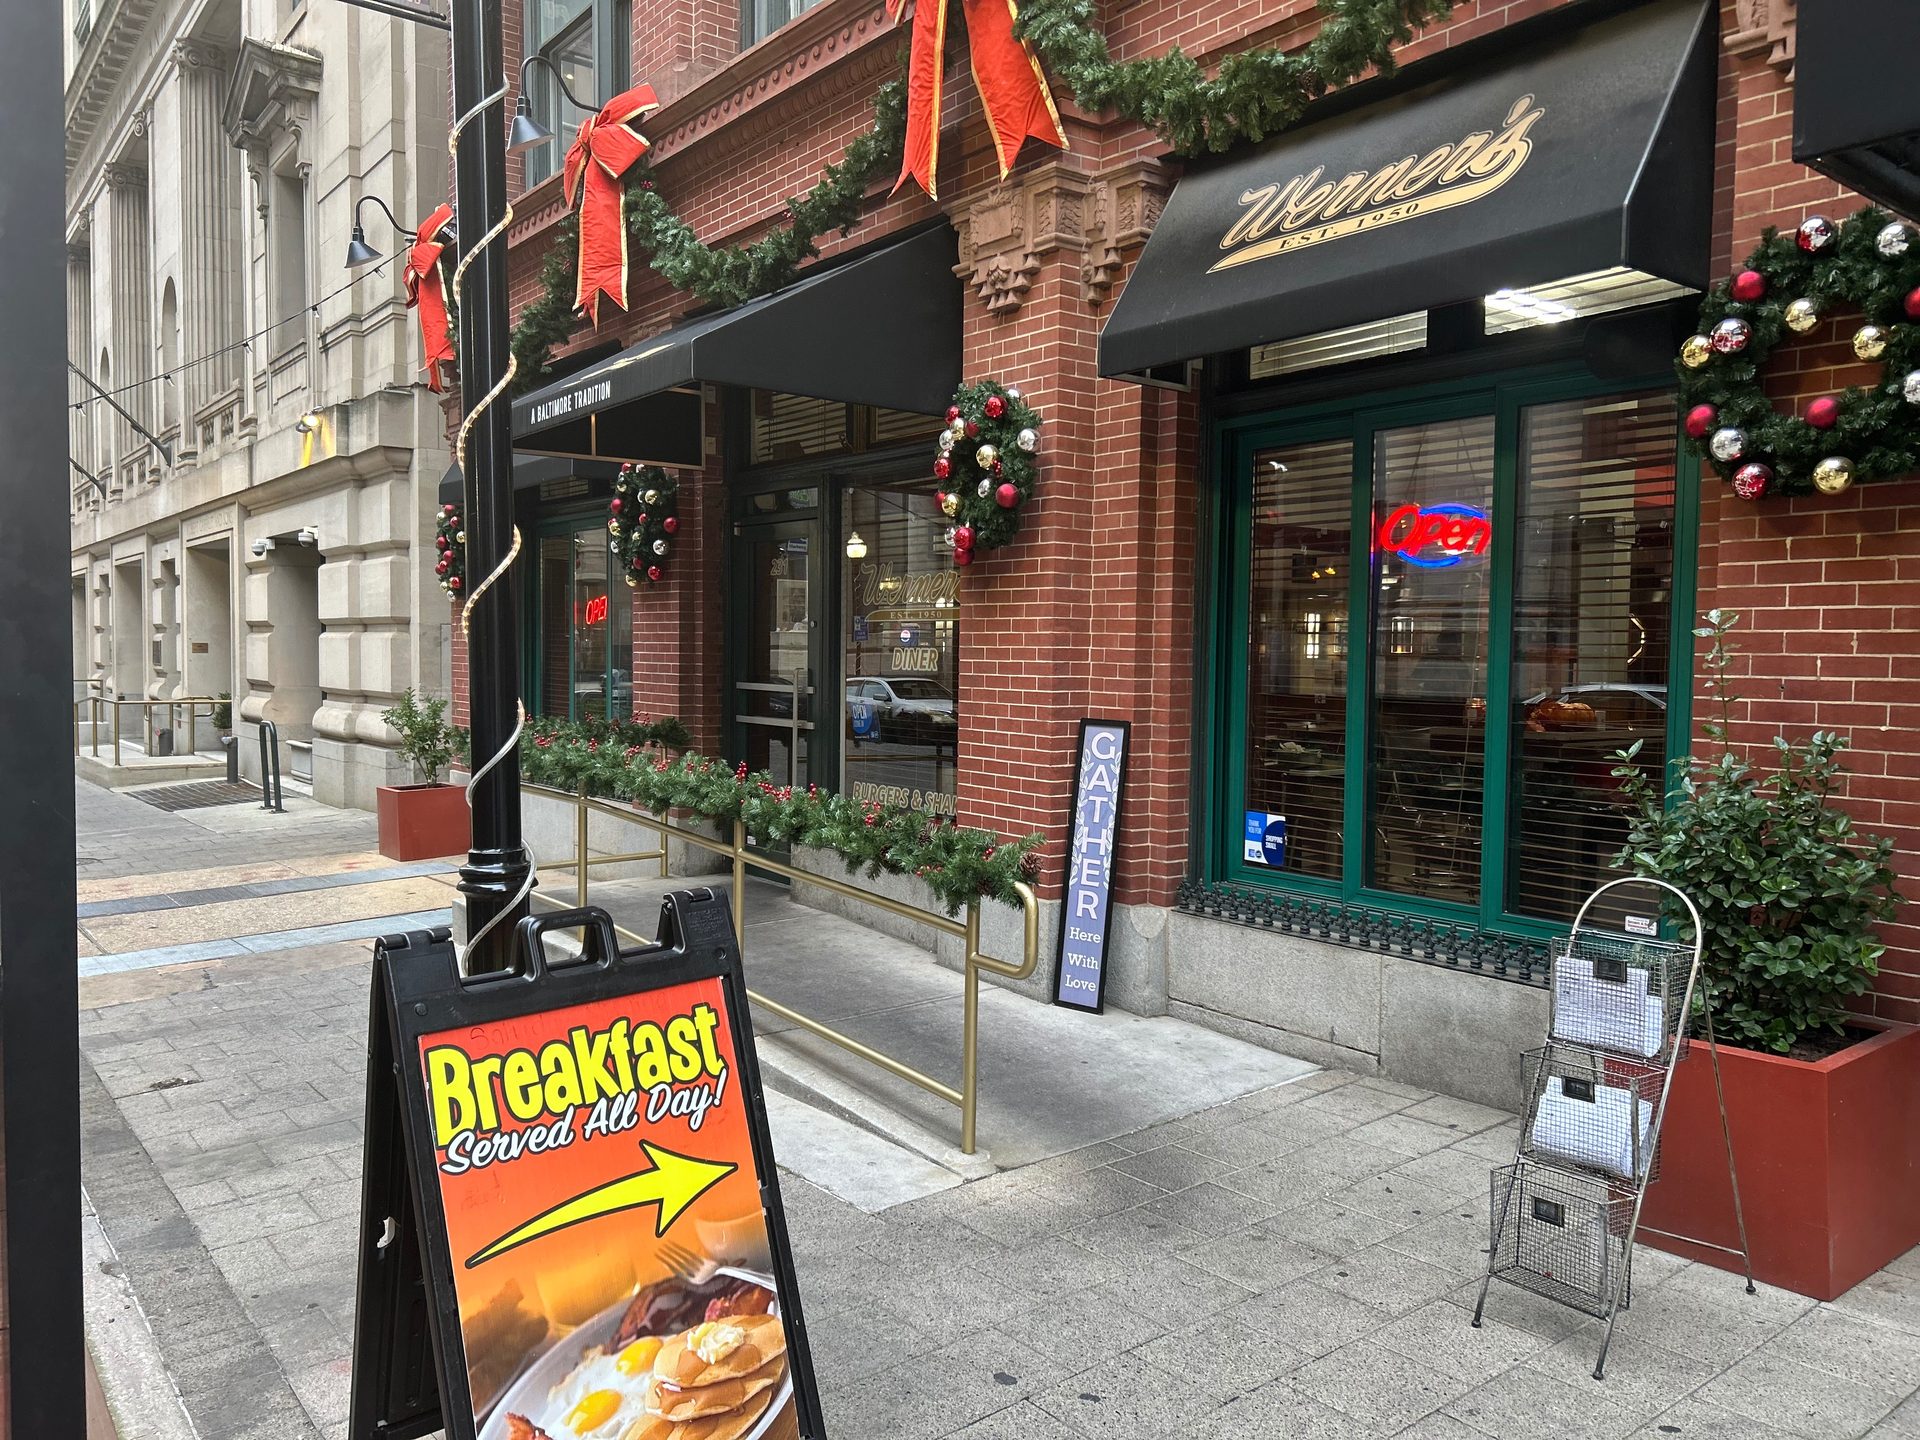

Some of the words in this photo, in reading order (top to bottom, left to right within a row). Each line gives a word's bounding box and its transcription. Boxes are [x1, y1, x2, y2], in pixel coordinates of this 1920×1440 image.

[1219, 92, 1545, 250] Werner's
[1279, 226, 1339, 250] EST.
[1356, 203, 1420, 229] 1950
[530, 408, 536, 425] A
[537, 394, 572, 422] BALTIMORE
[574, 380, 611, 410] TRADITION
[1381, 504, 1491, 556] Open
[860, 560, 960, 606] Werner
[890, 611, 914, 620] EST.
[918, 611, 943, 620] 1950
[892, 648, 939, 671] DINER
[853, 781, 910, 808] BURGERS
[911, 789, 923, 811] &
[1076, 732, 1116, 919] GATHER
[1069, 927, 1102, 944] Here
[1065, 974, 1097, 992] Love
[1067, 952, 1099, 970] With
[427, 1003, 726, 1148] Breakfast
[440, 1105, 575, 1173] Served
[584, 1092, 637, 1139] All
[649, 1068, 727, 1131] Day!
